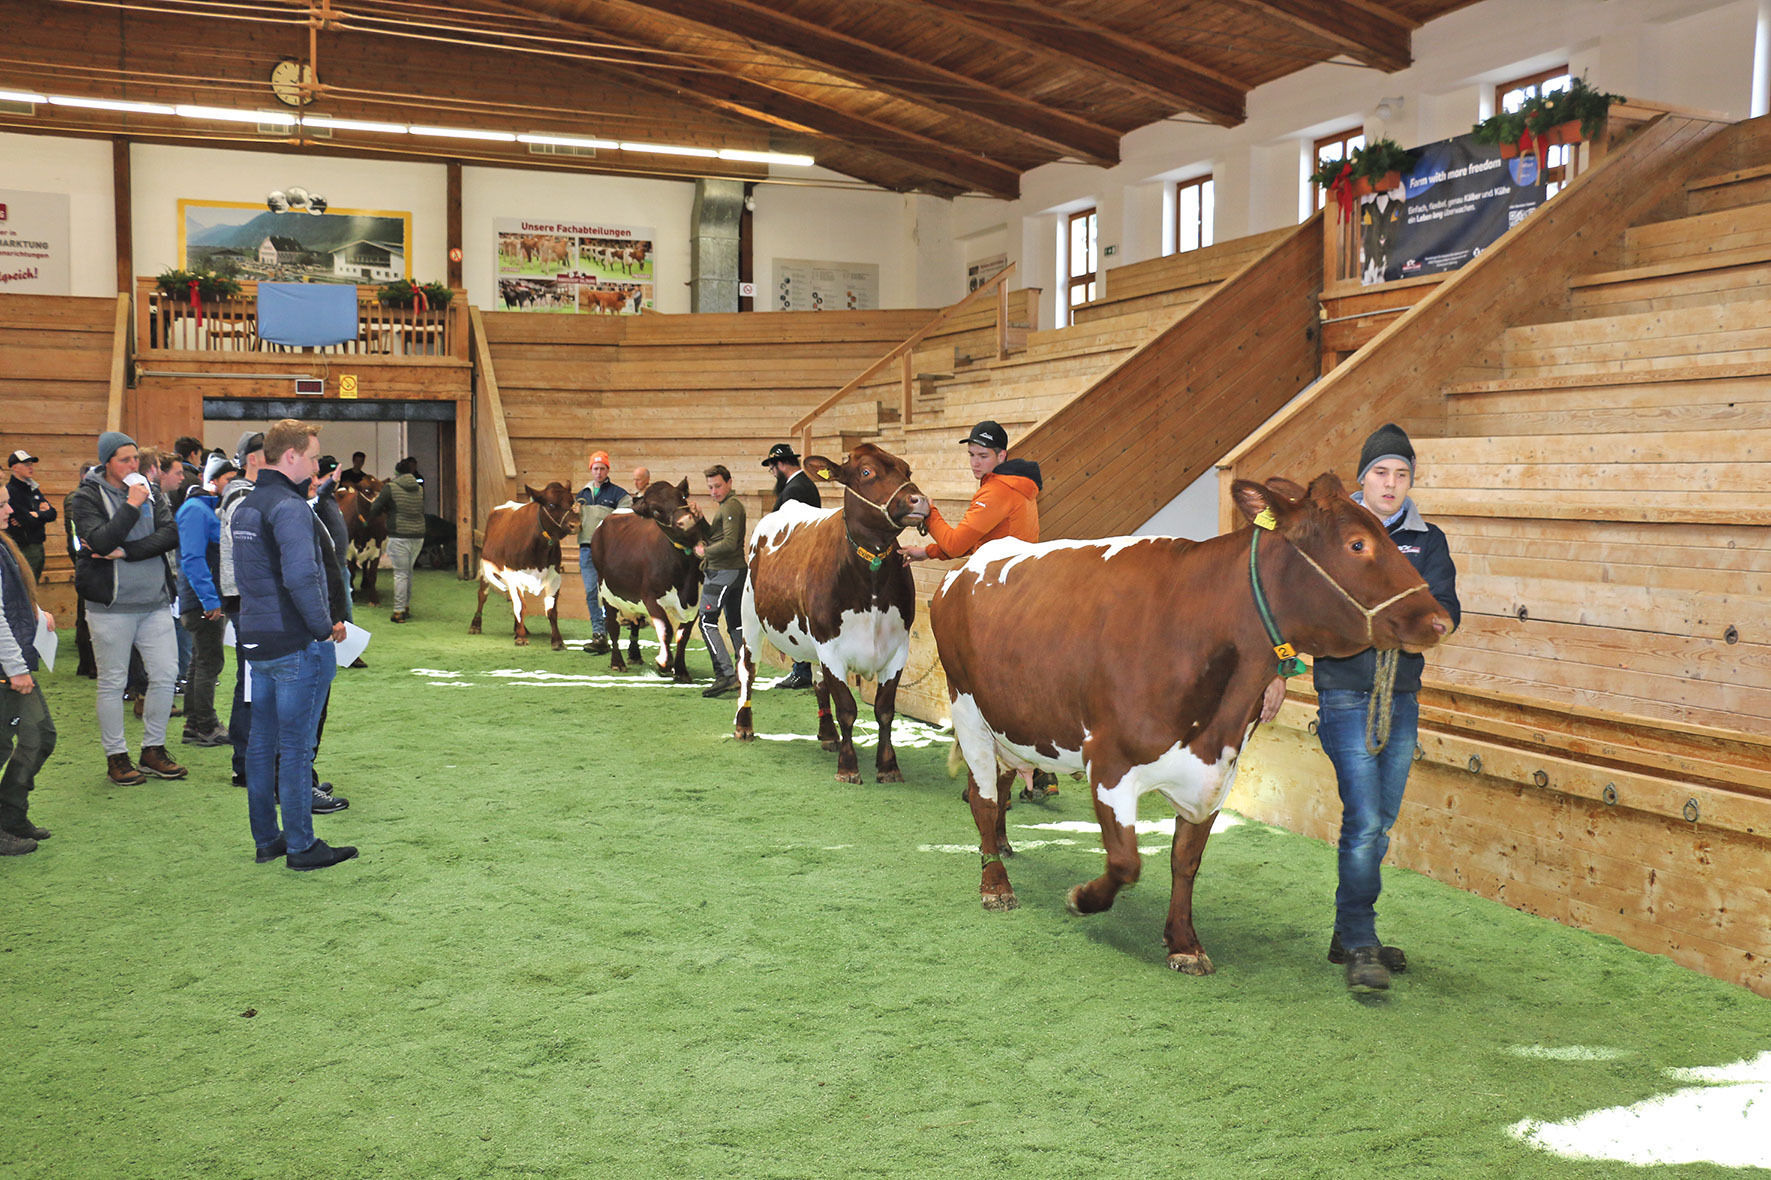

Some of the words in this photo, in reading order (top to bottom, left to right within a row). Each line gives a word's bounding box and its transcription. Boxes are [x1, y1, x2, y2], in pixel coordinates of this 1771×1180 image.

[1409, 177, 1428, 189] Farm
[1428, 172, 1447, 183] with
[1447, 167, 1467, 179] more
[1468, 158, 1502, 174] freedom
[1481, 189, 1493, 198] und
[1416, 213, 1432, 223] Leben
[1432, 210, 1444, 220] lang
[521, 222, 555, 232] Unsere
[556, 224, 632, 237] Fachabteilungen
[1278, 647, 1290, 657] 2
